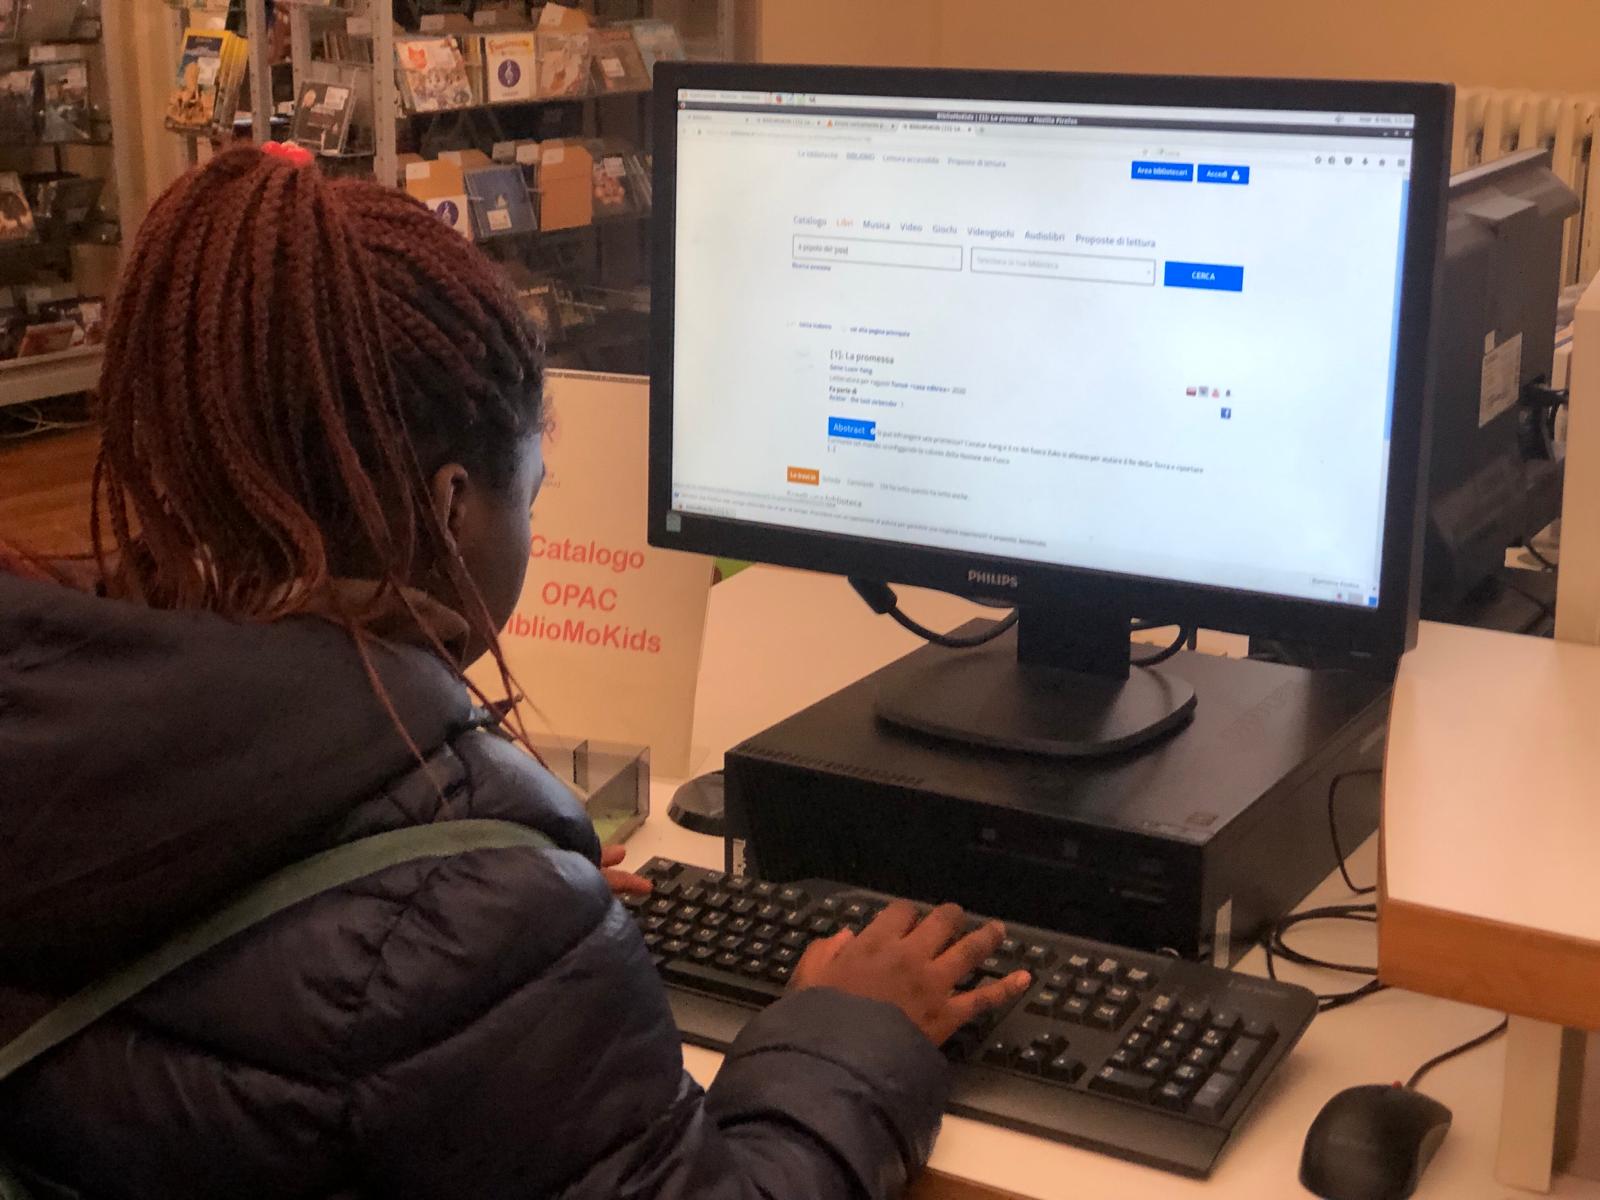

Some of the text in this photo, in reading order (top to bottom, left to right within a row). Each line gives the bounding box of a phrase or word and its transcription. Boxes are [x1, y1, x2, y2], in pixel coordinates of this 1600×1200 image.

[1137, 166, 1151, 175] Area
[1206, 168, 1227, 178] Accedi
[793, 215, 827, 228] Catalogo
[863, 220, 890, 230] Musica
[900, 222, 923, 232] Video
[932, 224, 957, 234] Giochi
[967, 226, 1014, 239] Videogiochi
[1024, 230, 1065, 242] Audiolibri
[1075, 233, 1156, 248] Proposte di lettura
[1192, 272, 1215, 281] CERCA
[856, 353, 894, 364] promessa
[833, 423, 865, 435] Abstract
[530, 535, 645, 573] Catalogo
[967, 570, 1018, 588] PHILIPS
[542, 581, 618, 612] OPAC
[507, 613, 662, 653] iblioMoKids
